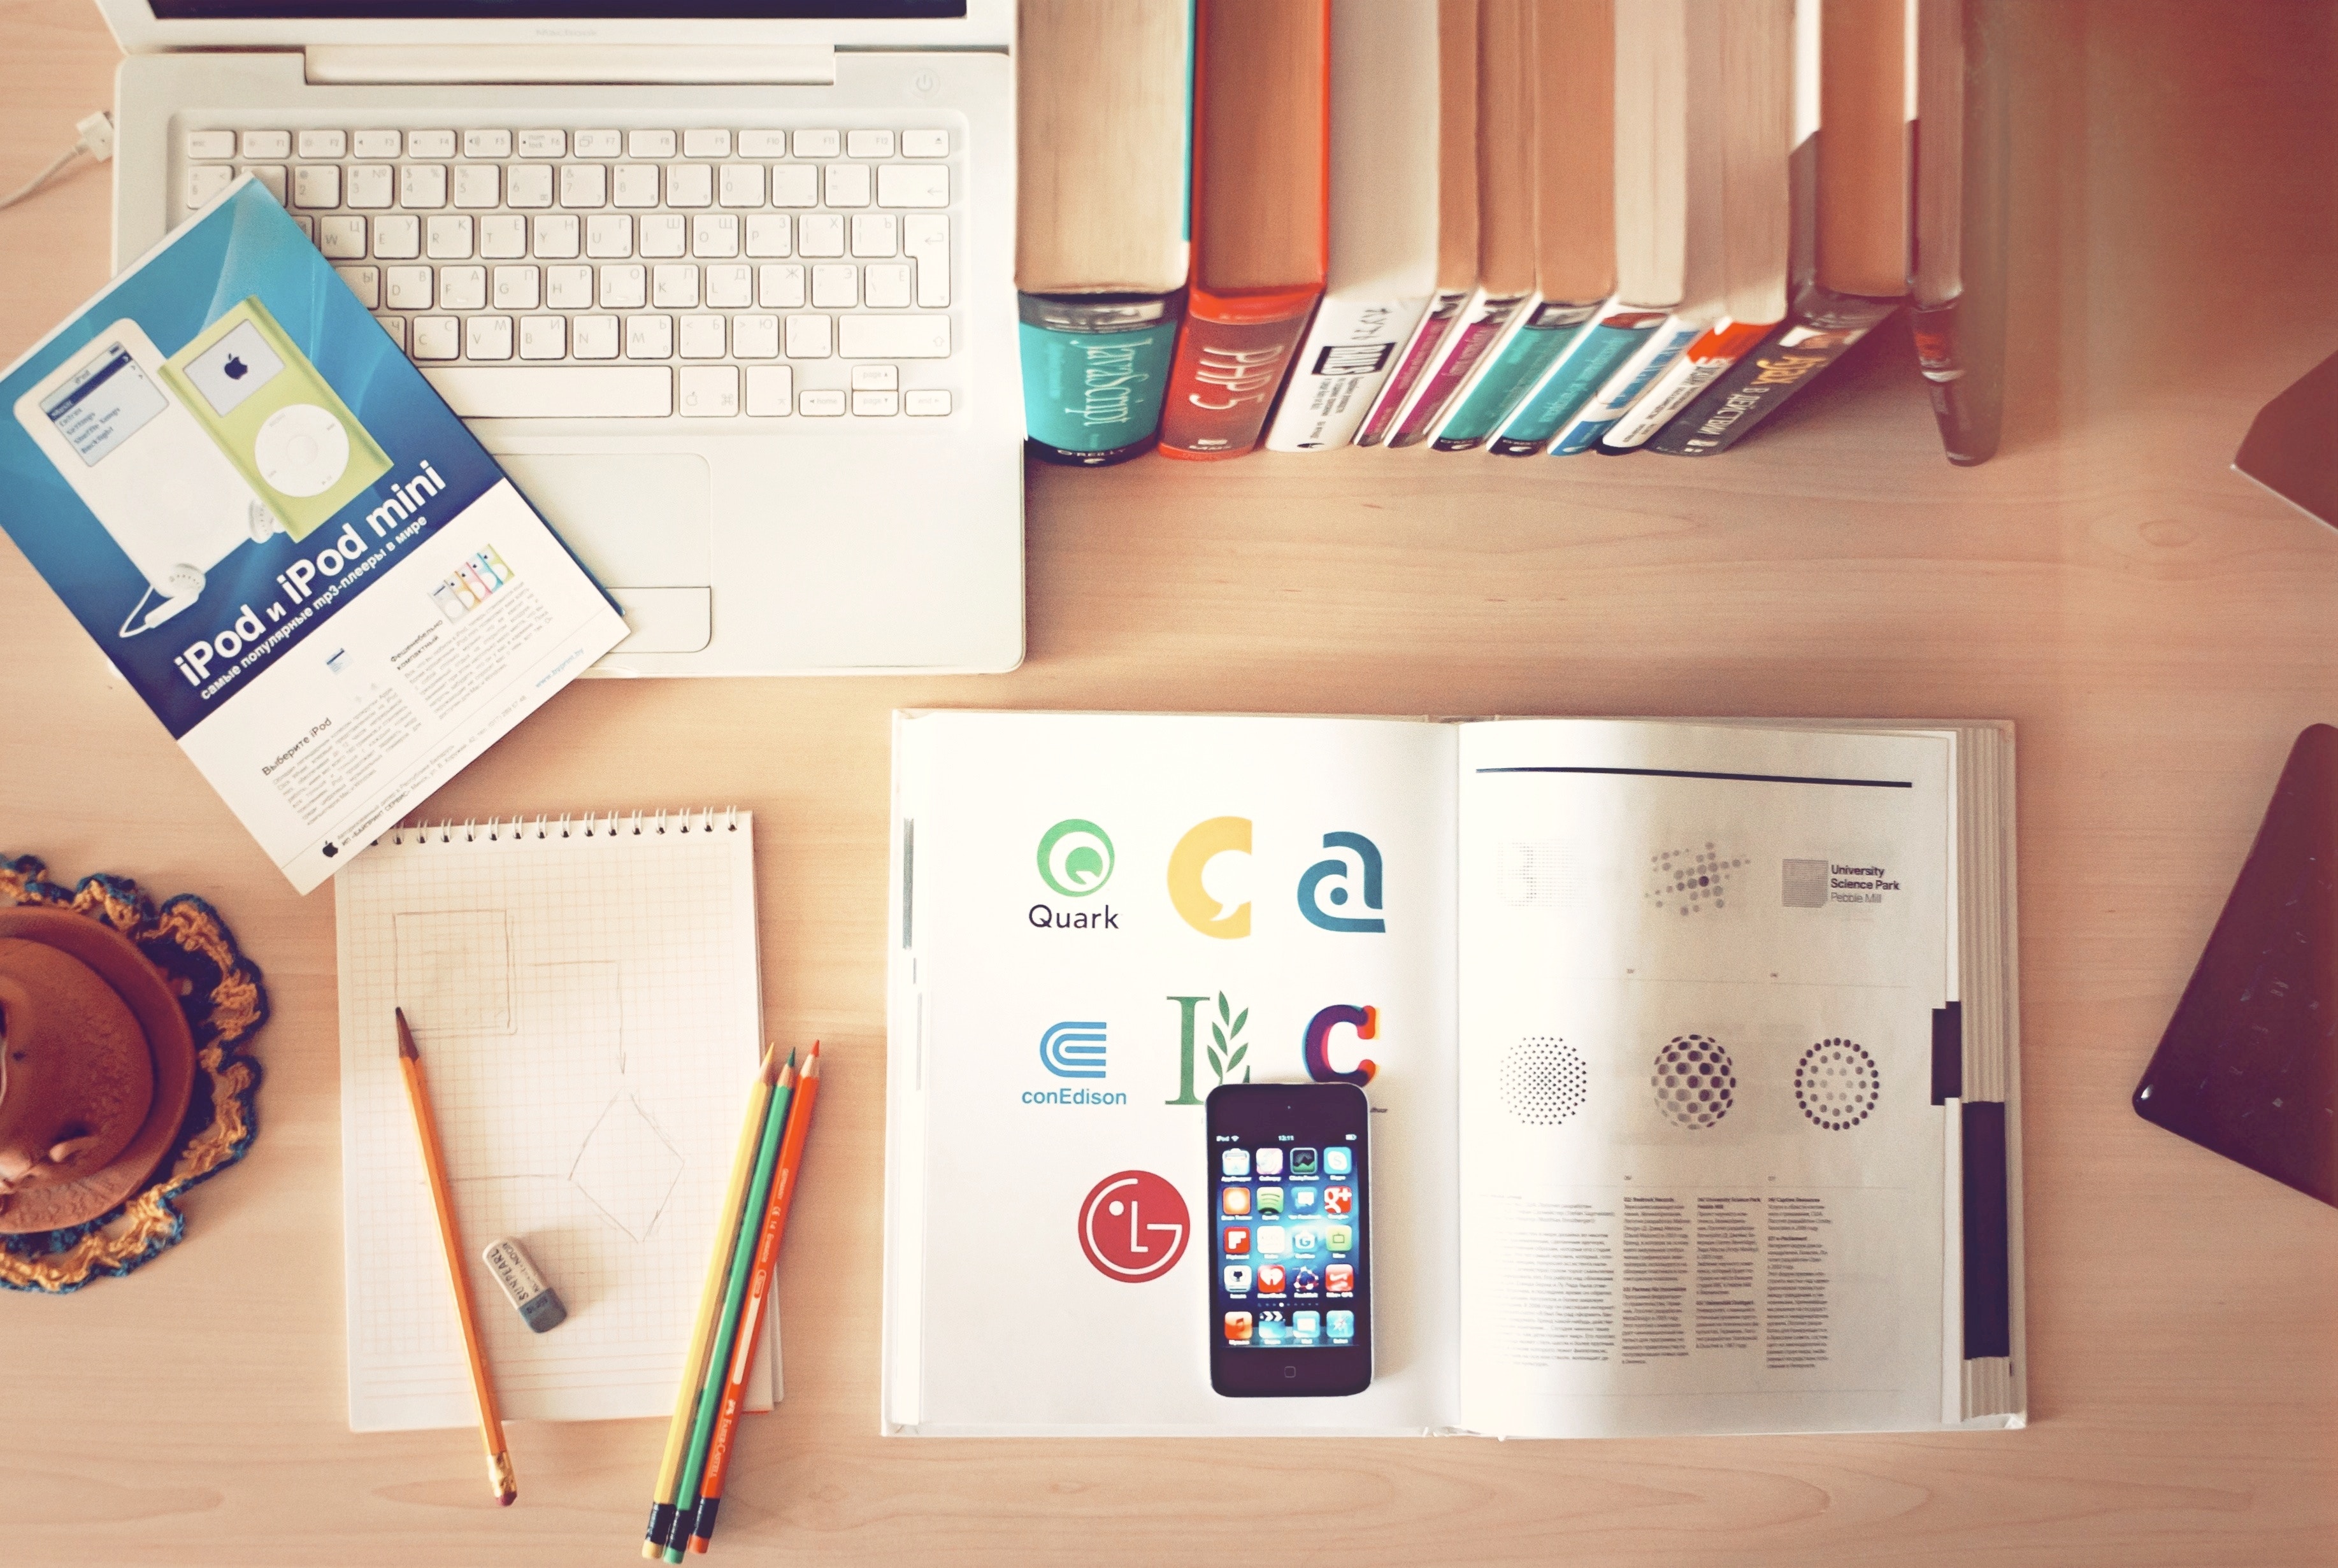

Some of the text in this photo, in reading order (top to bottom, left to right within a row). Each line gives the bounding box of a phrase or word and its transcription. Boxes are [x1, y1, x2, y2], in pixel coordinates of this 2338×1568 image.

[1065, 338, 1153, 427] JavaScript
[1195, 346, 1284, 392] PHP
[1189, 389, 1263, 410] 5
[176, 461, 444, 685] iPod и iPod mini
[202, 666, 240, 699] самые
[241, 608, 312, 667] популярные
[314, 550, 385, 609] mp3-плееры
[396, 517, 426, 543] мире
[262, 718, 331, 775] Выберите iPod
[1831, 864, 1884, 877] University
[1831, 879, 1900, 890] Science Park
[1029, 904, 1119, 929] Quark
[1022, 1088, 1127, 1105] conEdison
[491, 1248, 529, 1301] SUNPEARL
